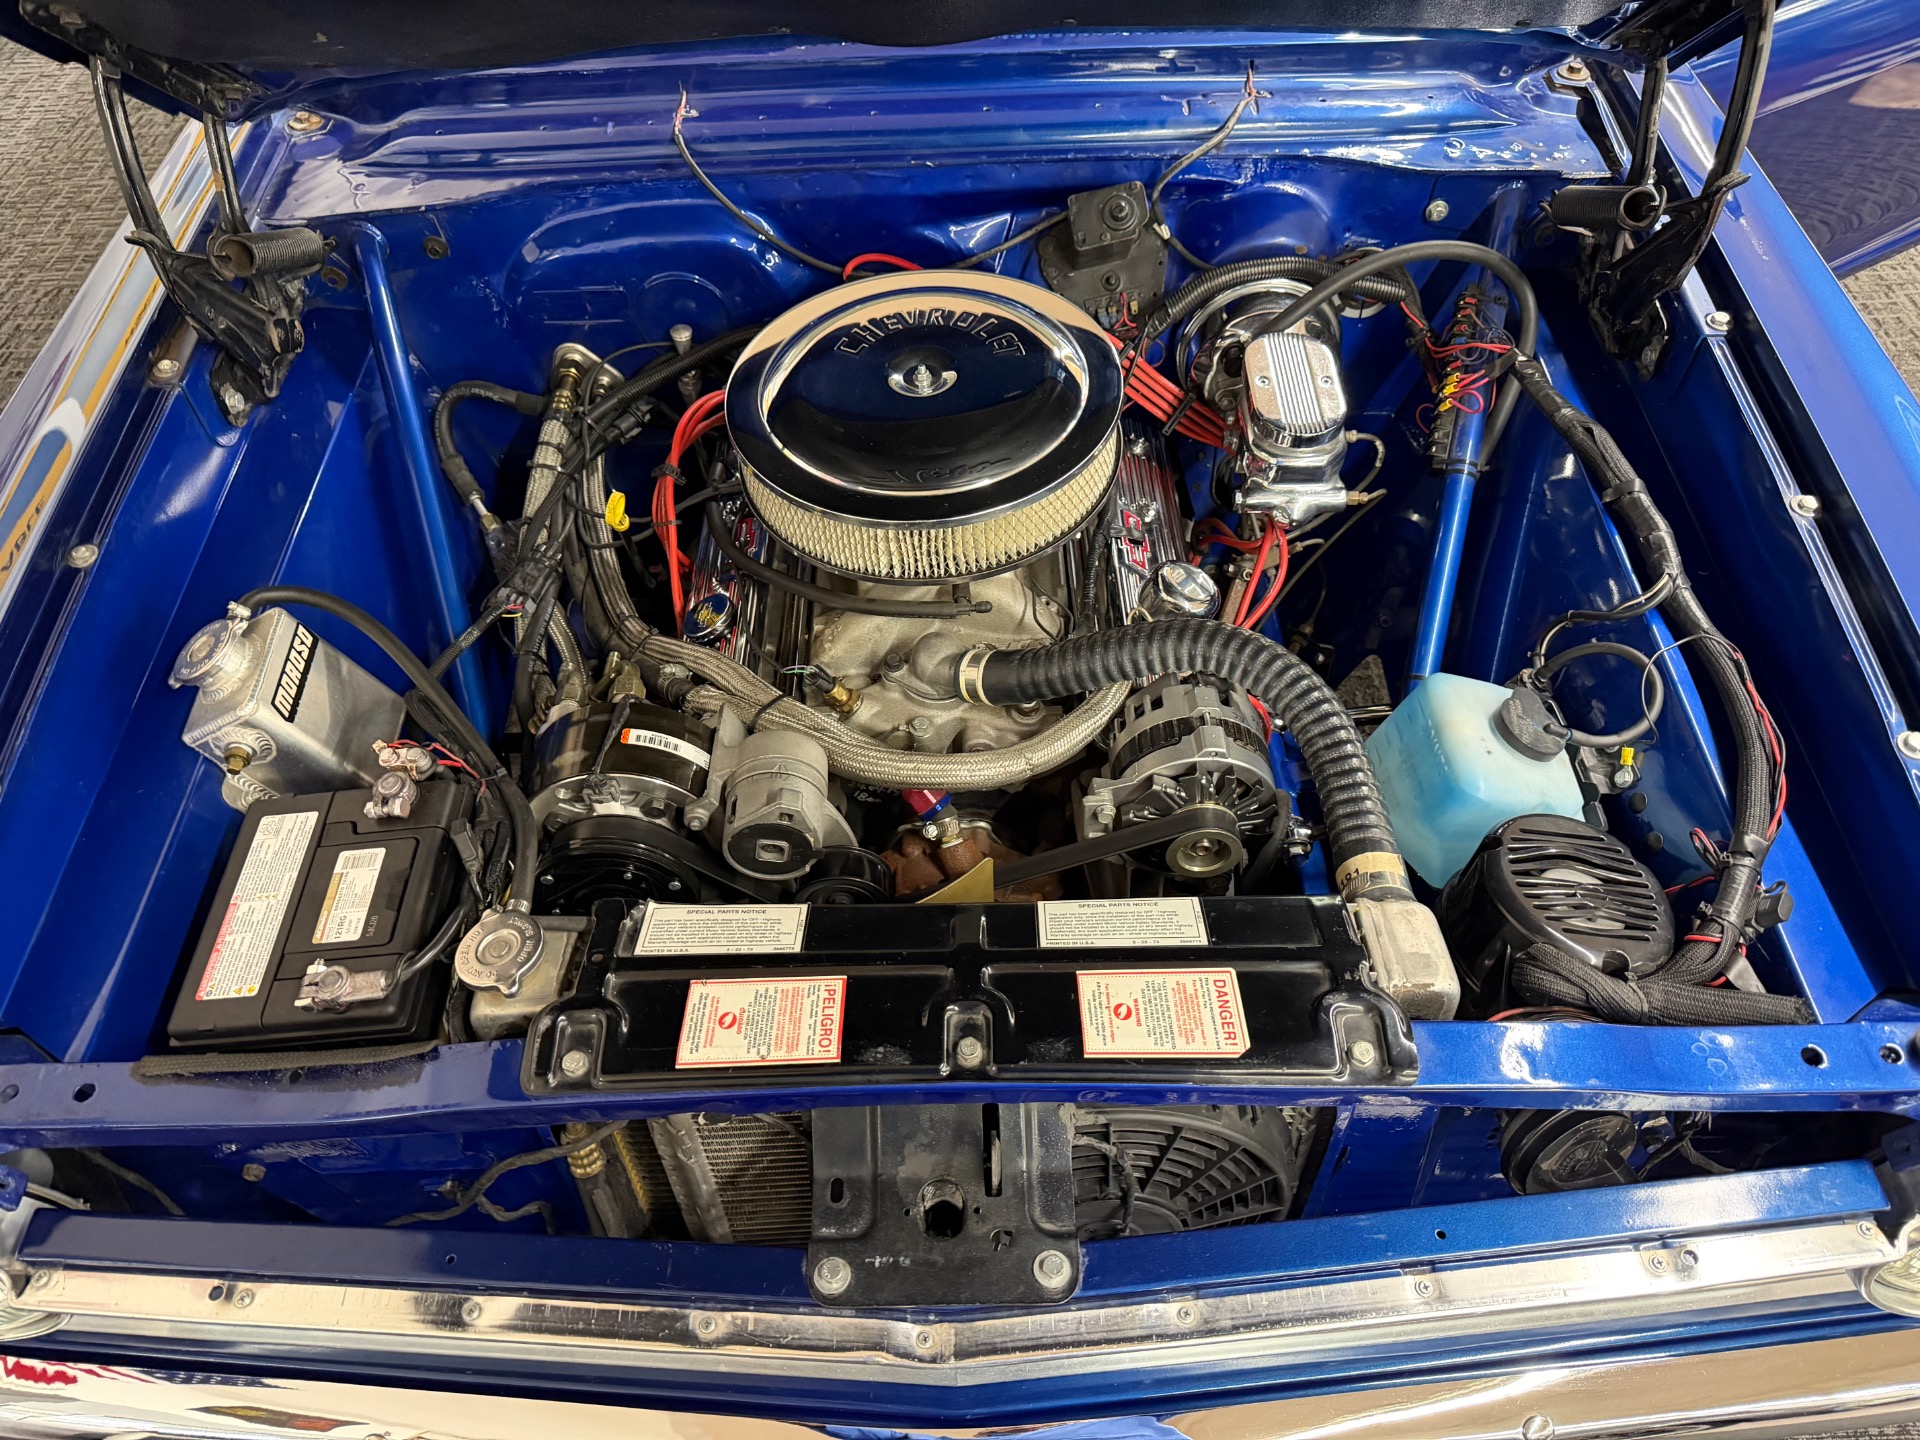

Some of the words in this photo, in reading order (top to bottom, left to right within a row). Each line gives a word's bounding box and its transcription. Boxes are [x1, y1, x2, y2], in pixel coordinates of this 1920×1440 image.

[834, 307, 1026, 356] CHEVROLET
[274, 623, 314, 719] MOROSO
[1133, 998, 1141, 1026] WARNING
[1213, 979, 1237, 1046] DANGER!
